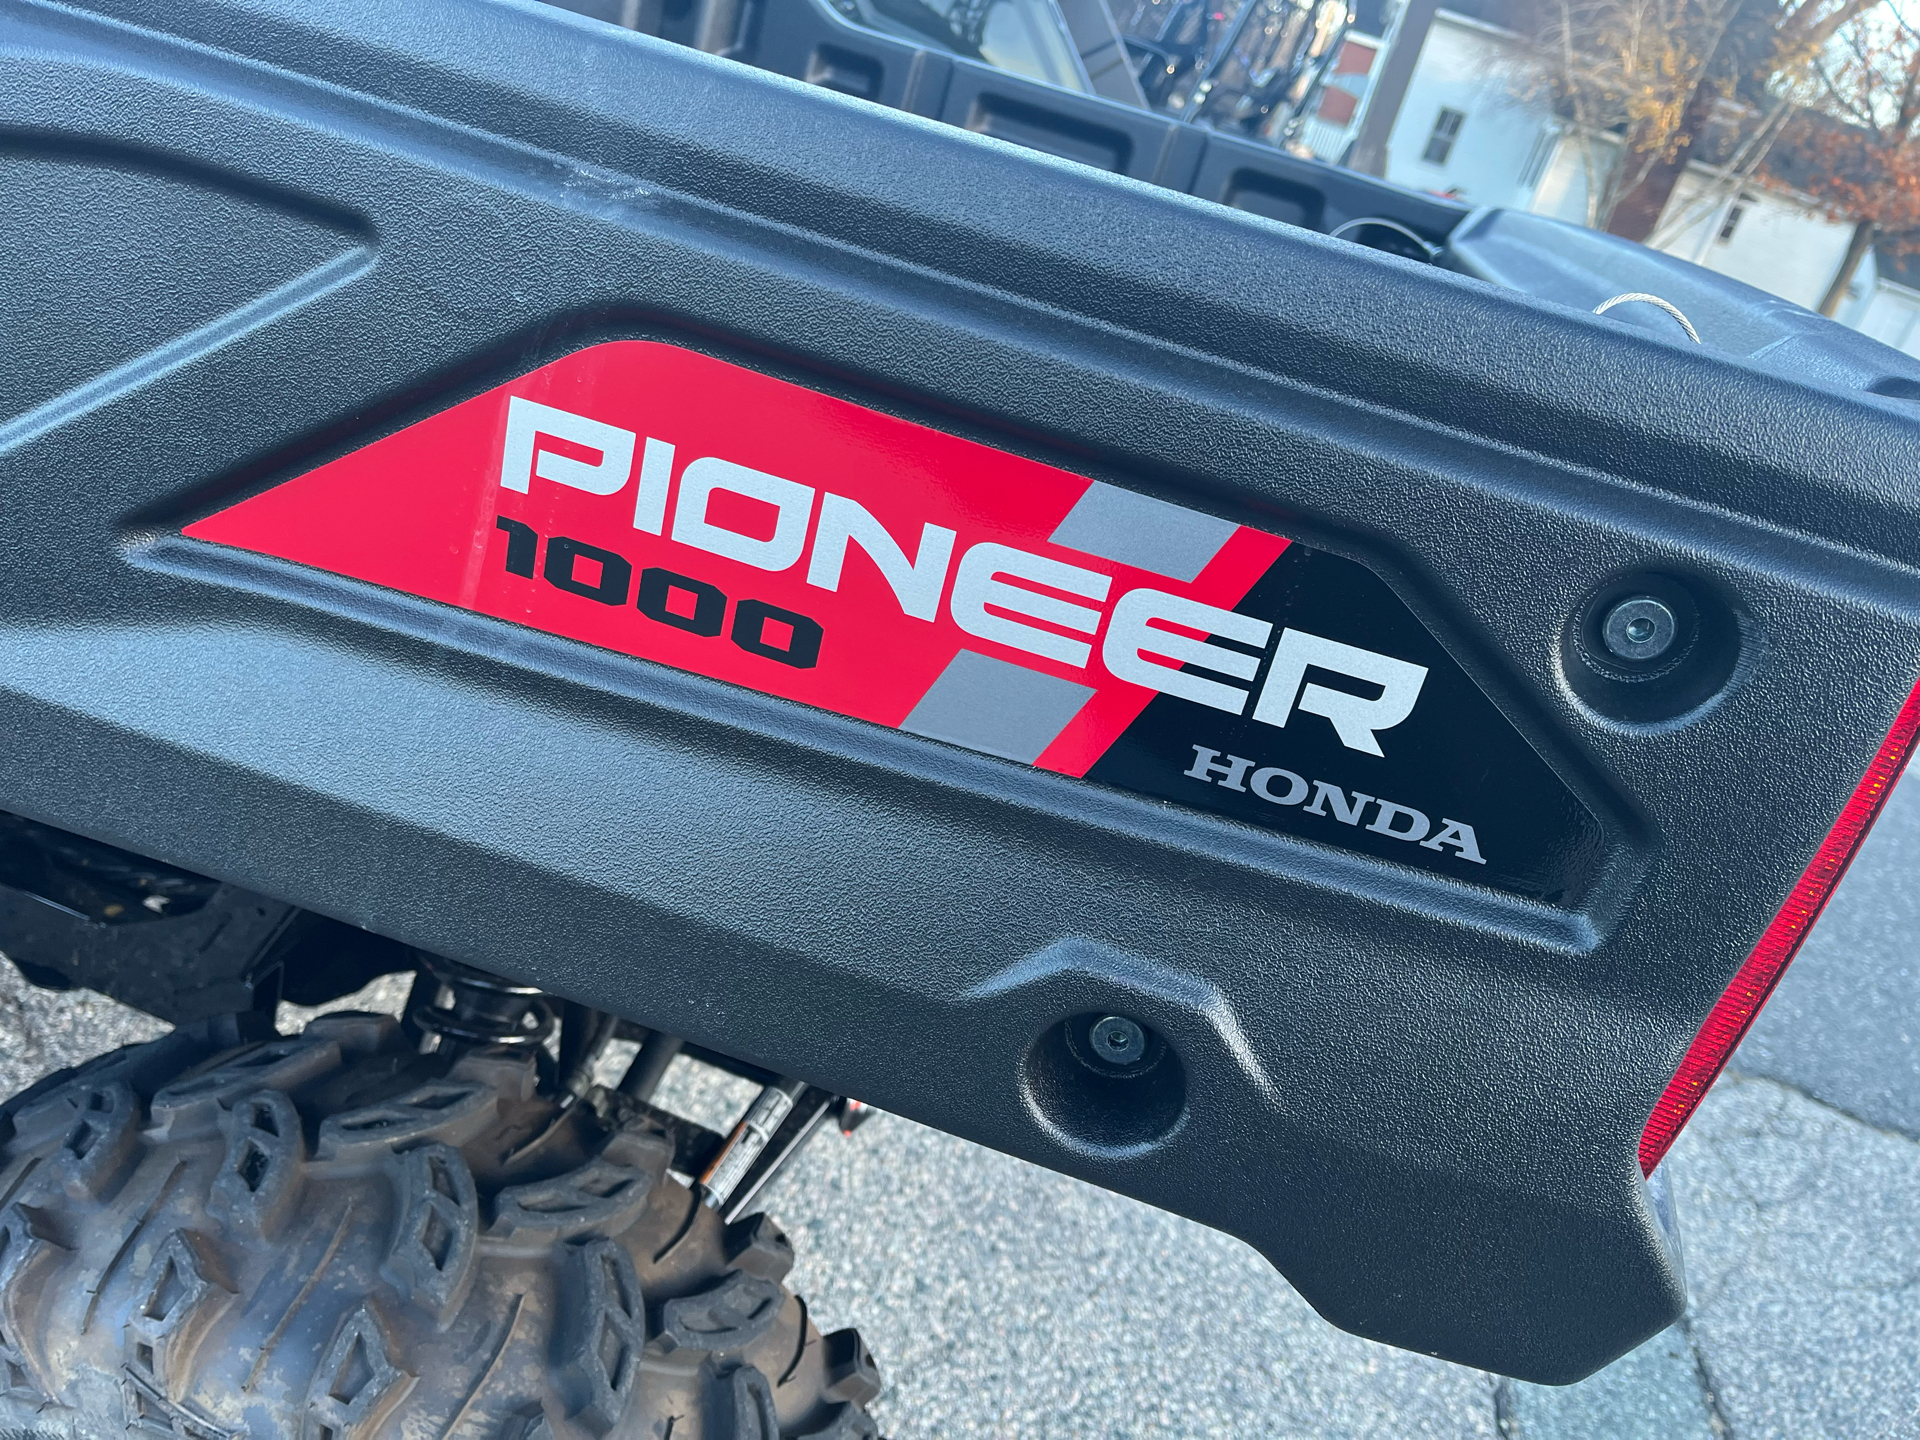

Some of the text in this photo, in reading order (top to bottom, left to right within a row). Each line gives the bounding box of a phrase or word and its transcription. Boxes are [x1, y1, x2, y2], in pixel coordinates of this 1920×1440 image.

[496, 516, 824, 669] 1000
[499, 396, 1429, 758] PIONEER
[1184, 745, 1486, 865] HONDA
